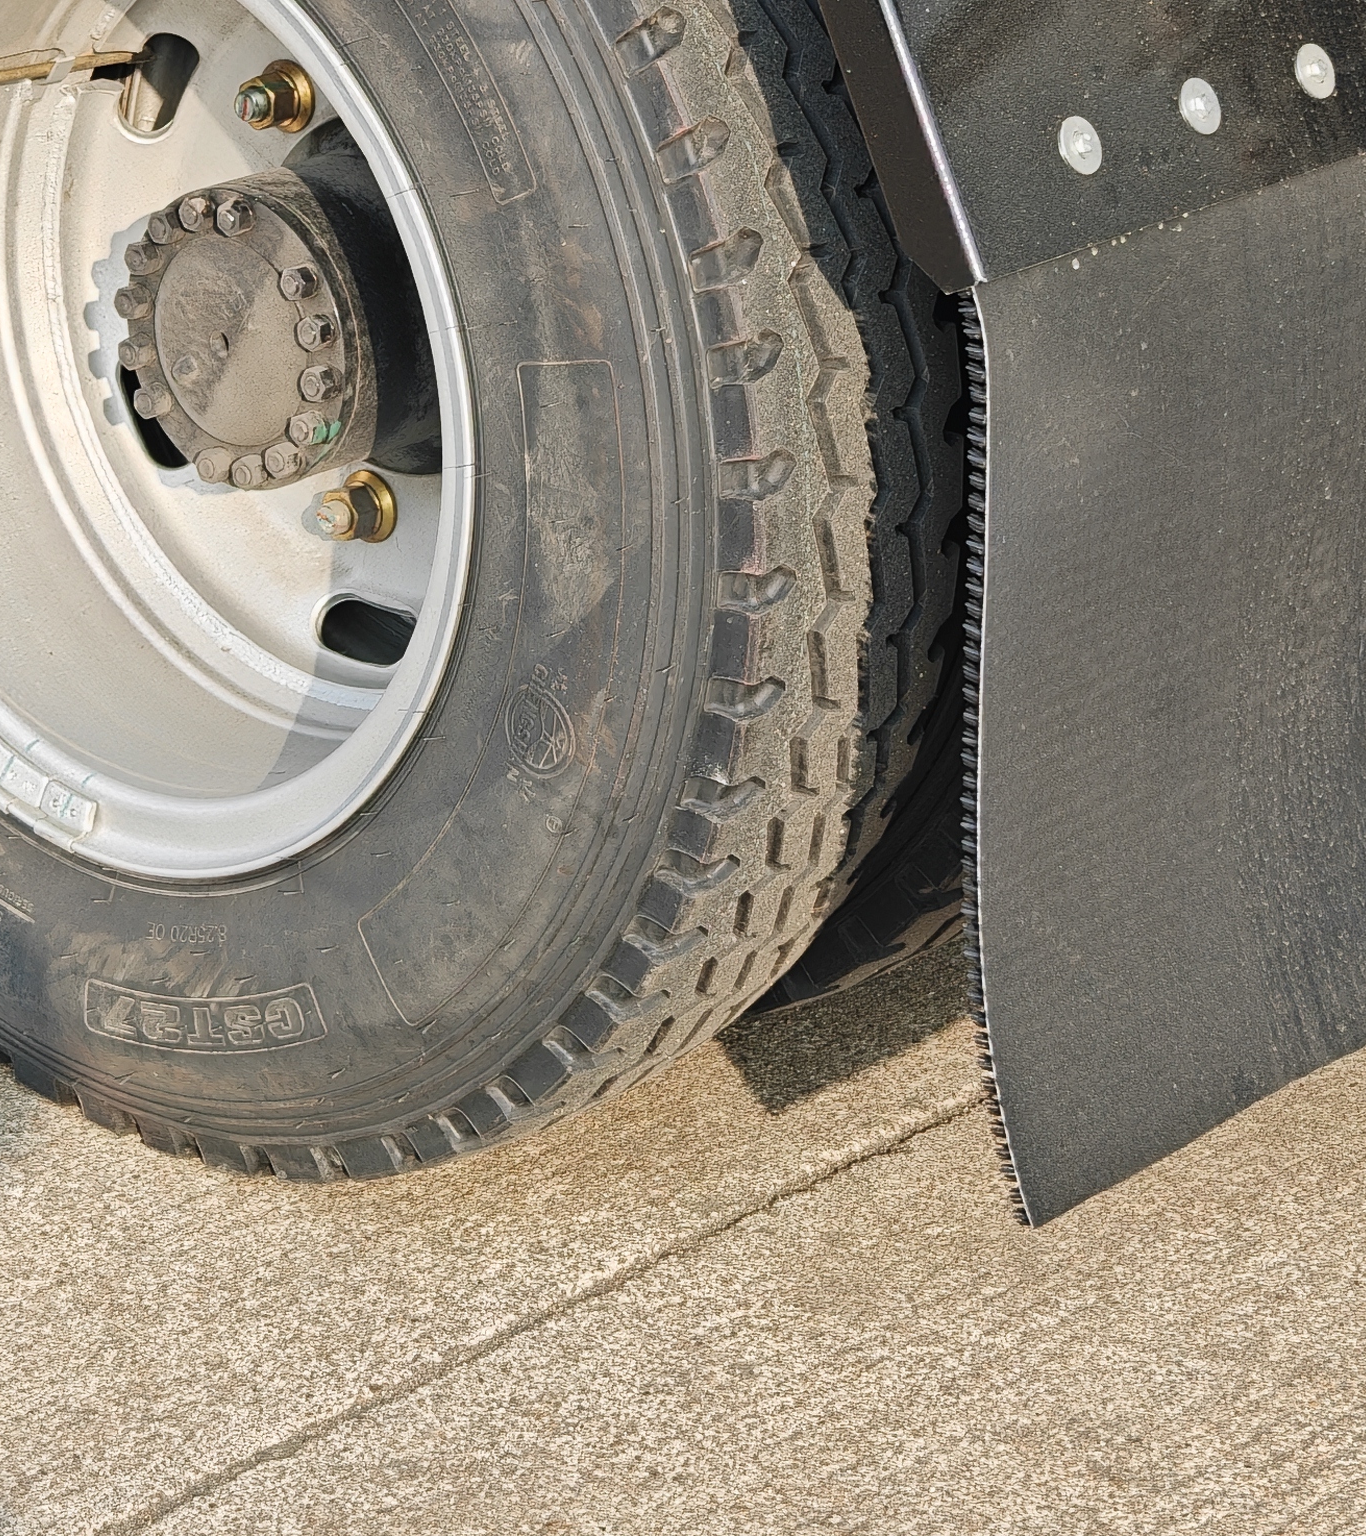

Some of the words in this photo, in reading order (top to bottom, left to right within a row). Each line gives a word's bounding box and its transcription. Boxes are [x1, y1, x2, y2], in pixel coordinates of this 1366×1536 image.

[445, 20, 473, 62] STEEL
[146, 920, 165, 942] OE
[169, 920, 227, 946] 8.25R20
[104, 995, 306, 1048] CST27
